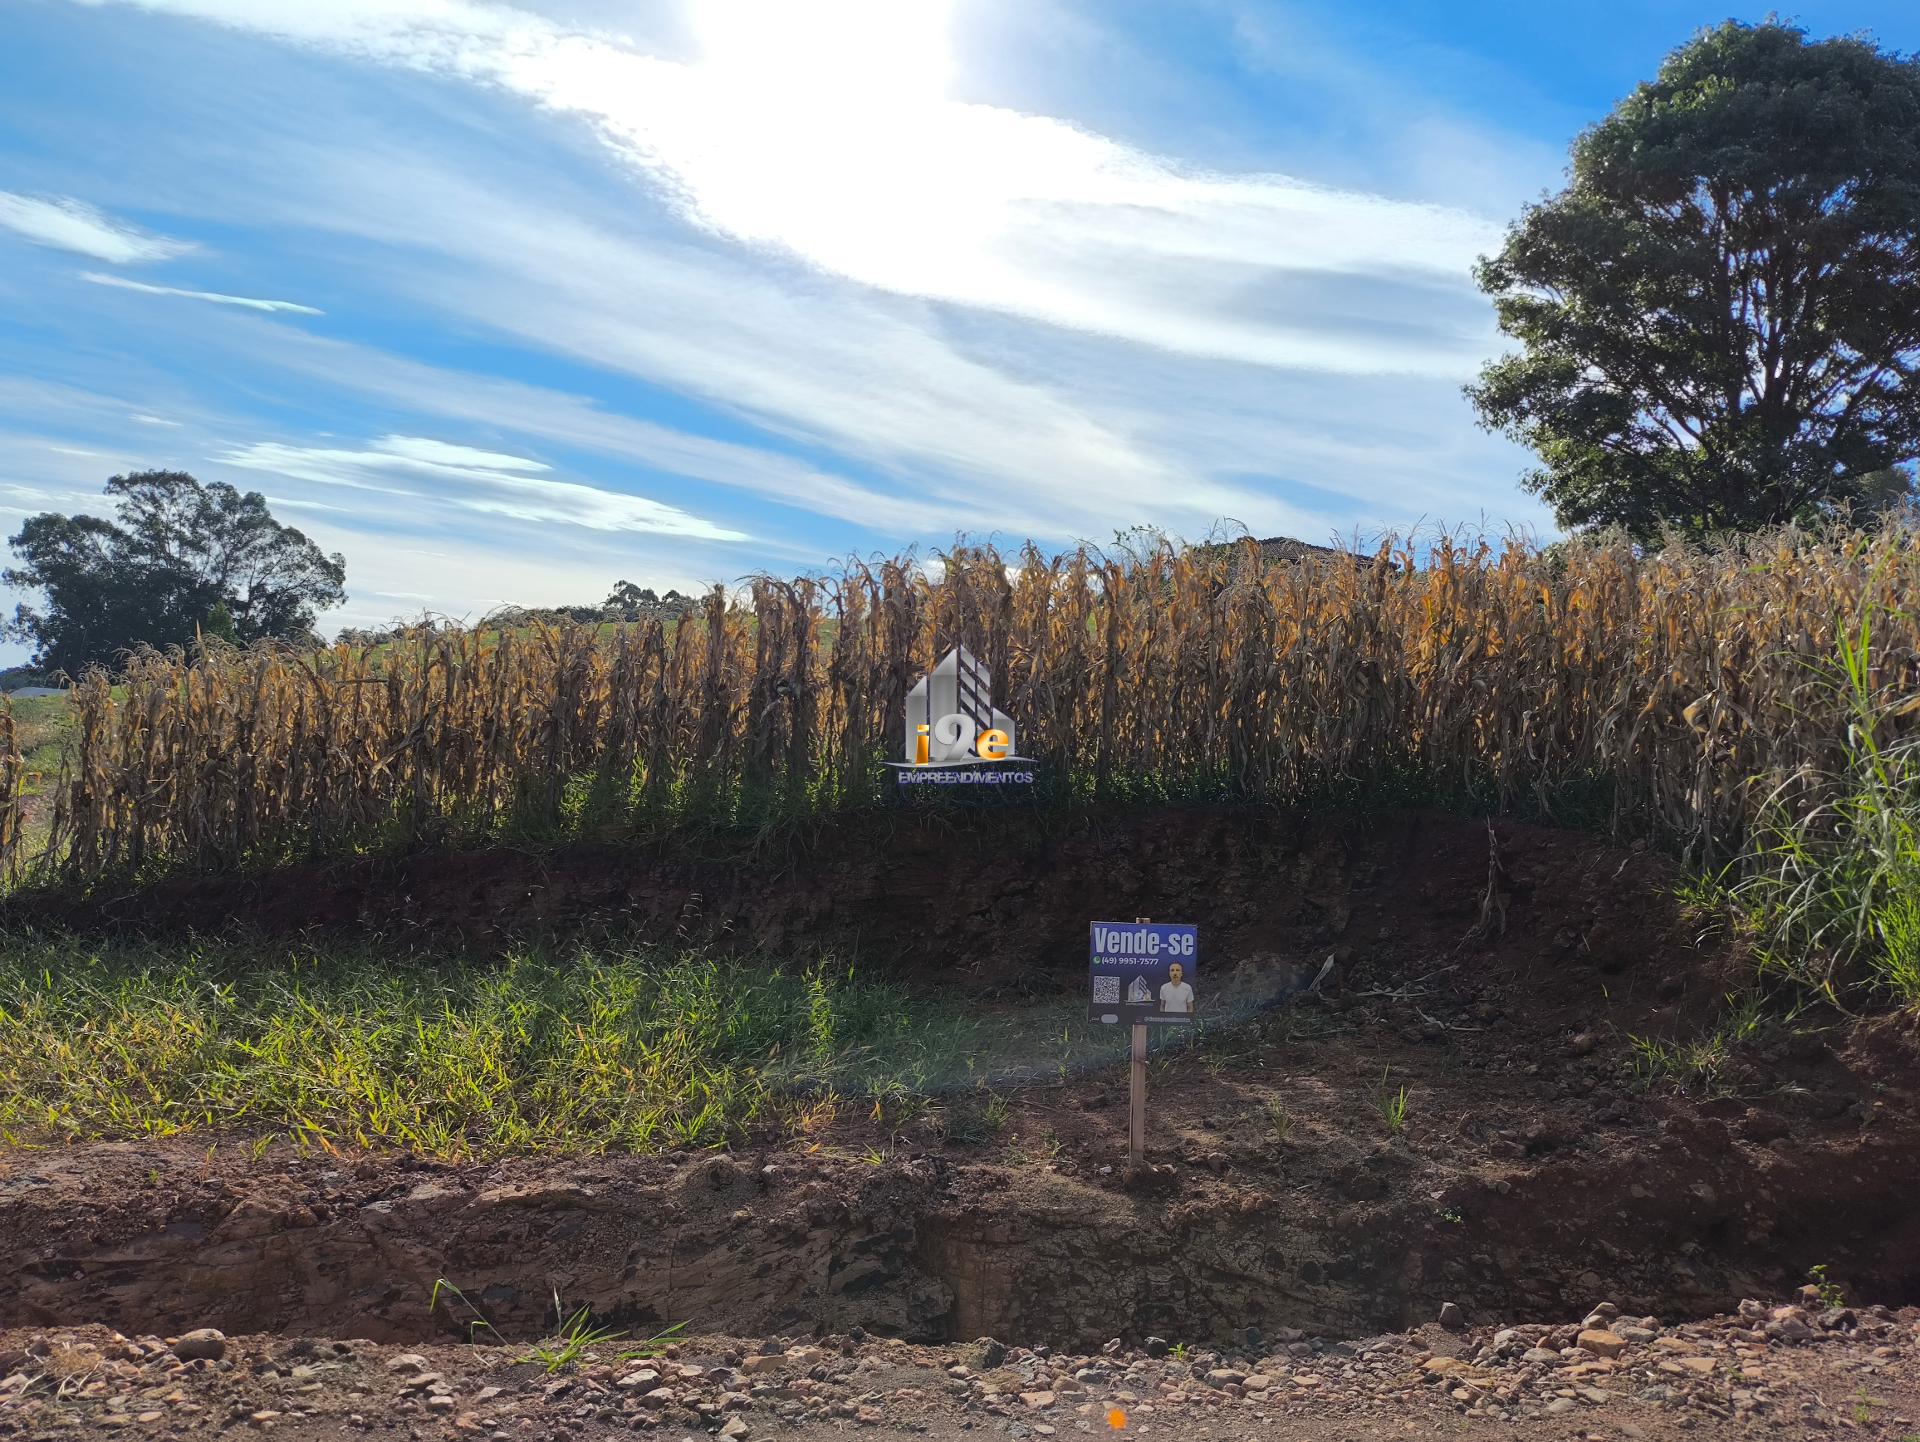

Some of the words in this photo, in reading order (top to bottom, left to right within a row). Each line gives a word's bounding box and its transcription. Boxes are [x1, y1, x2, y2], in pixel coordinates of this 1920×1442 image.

[1094, 928, 1193, 955] Vende-se
[1102, 957, 1117, 965] (49)
[1119, 957, 1159, 965] 9951-7577
